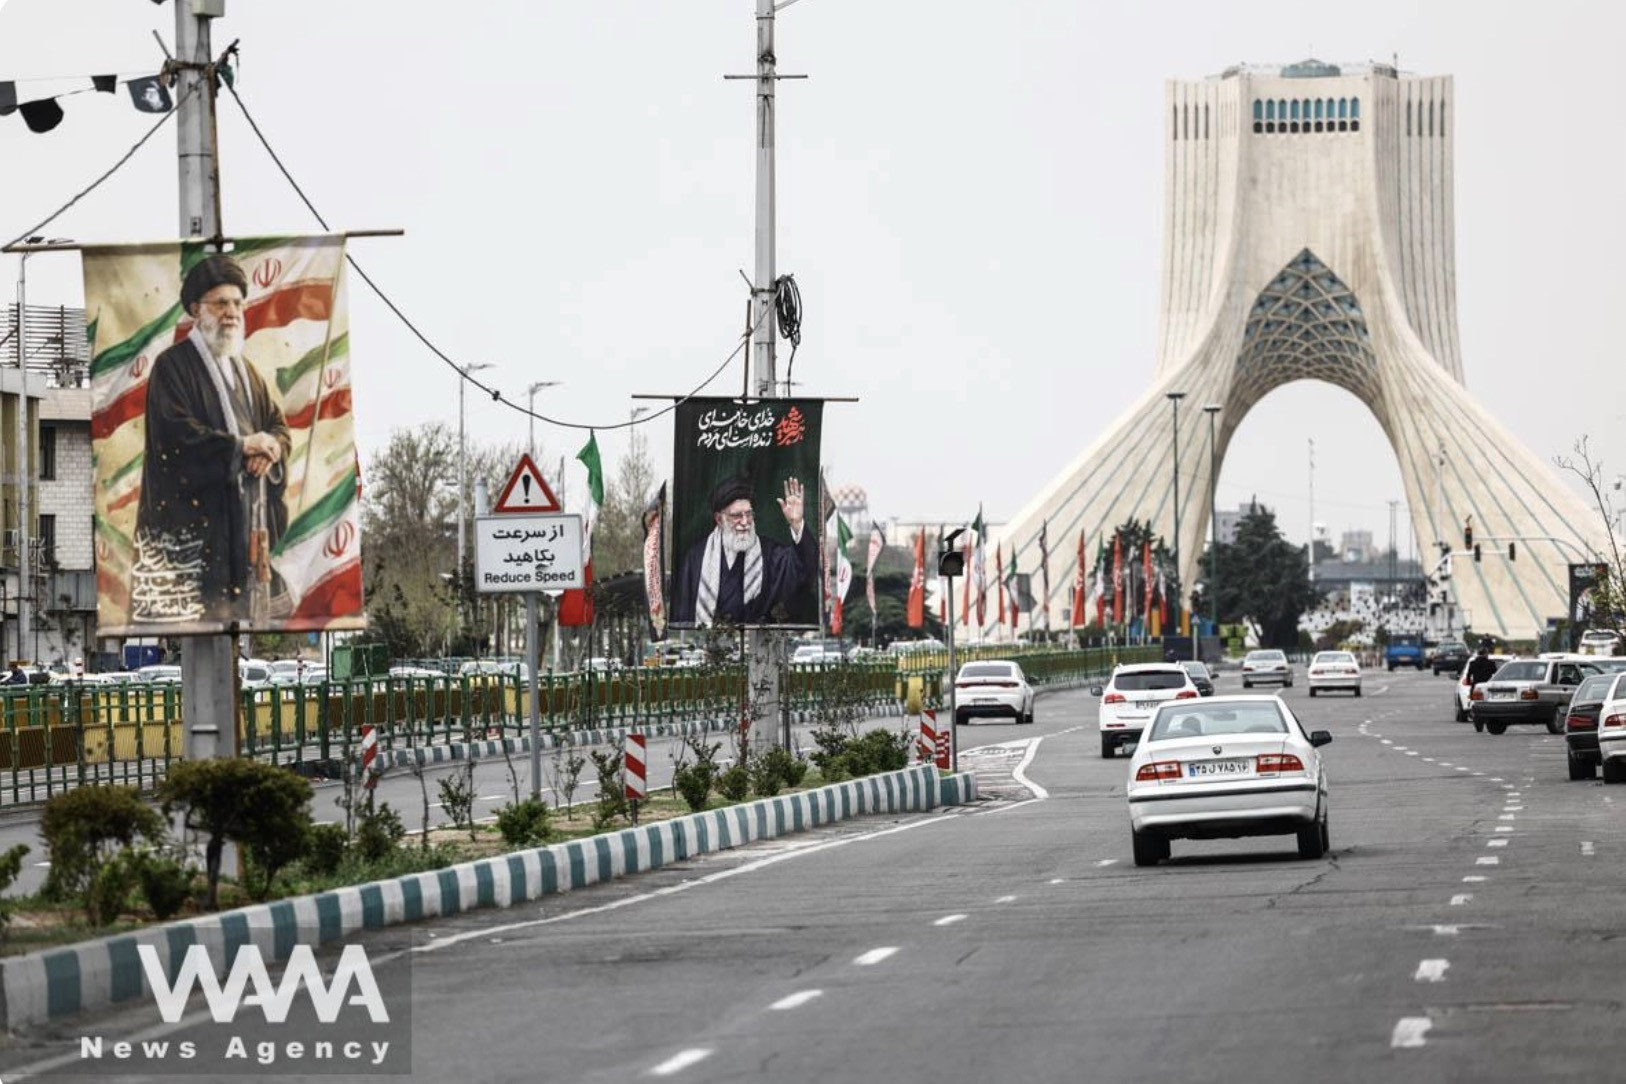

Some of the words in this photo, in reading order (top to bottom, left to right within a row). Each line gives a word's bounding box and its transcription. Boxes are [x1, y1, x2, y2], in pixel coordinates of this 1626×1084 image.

[726, 430, 753, 448] است
[753, 431, 773, 448] زنده
[492, 528, 546, 543] سرعت
[548, 524, 564, 542] از
[503, 549, 556, 566] بکاهید
[485, 572, 531, 583] Reduce
[535, 570, 575, 583] Speed
